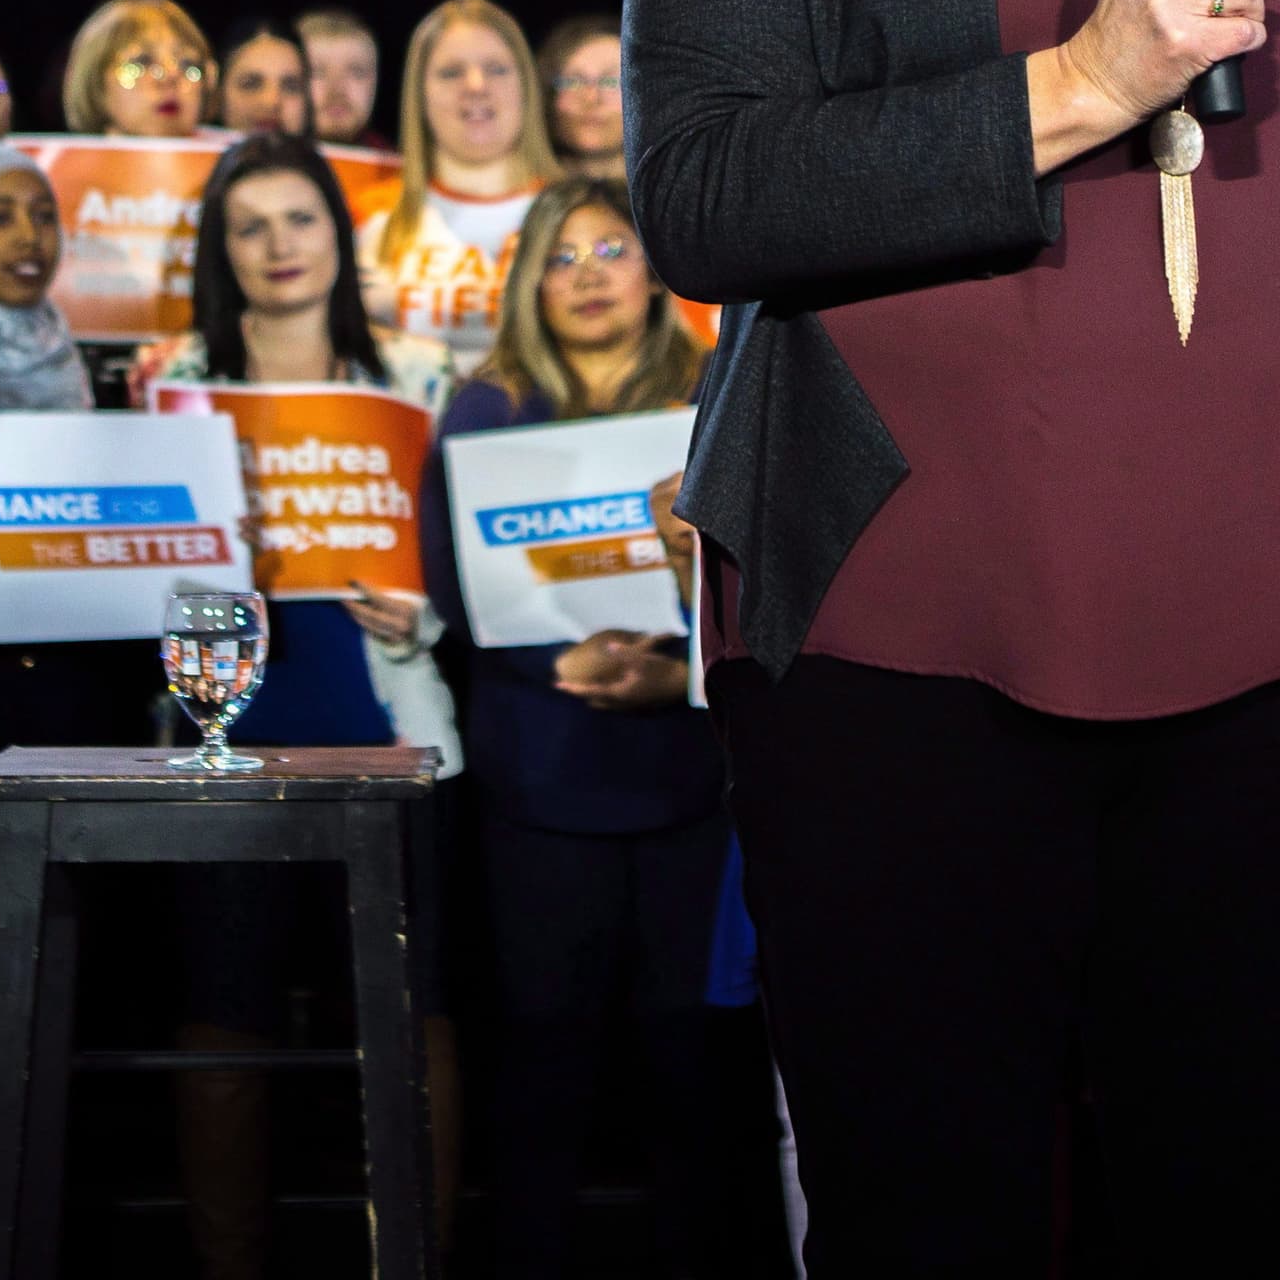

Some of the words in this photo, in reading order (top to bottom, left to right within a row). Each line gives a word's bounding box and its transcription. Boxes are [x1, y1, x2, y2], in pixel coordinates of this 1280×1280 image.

[77, 187, 203, 226] Andr
[246, 477, 413, 520] rwath
[492, 496, 647, 540] CHANGE
[32, 541, 81, 565] THE
[83, 532, 219, 563] BETTER
